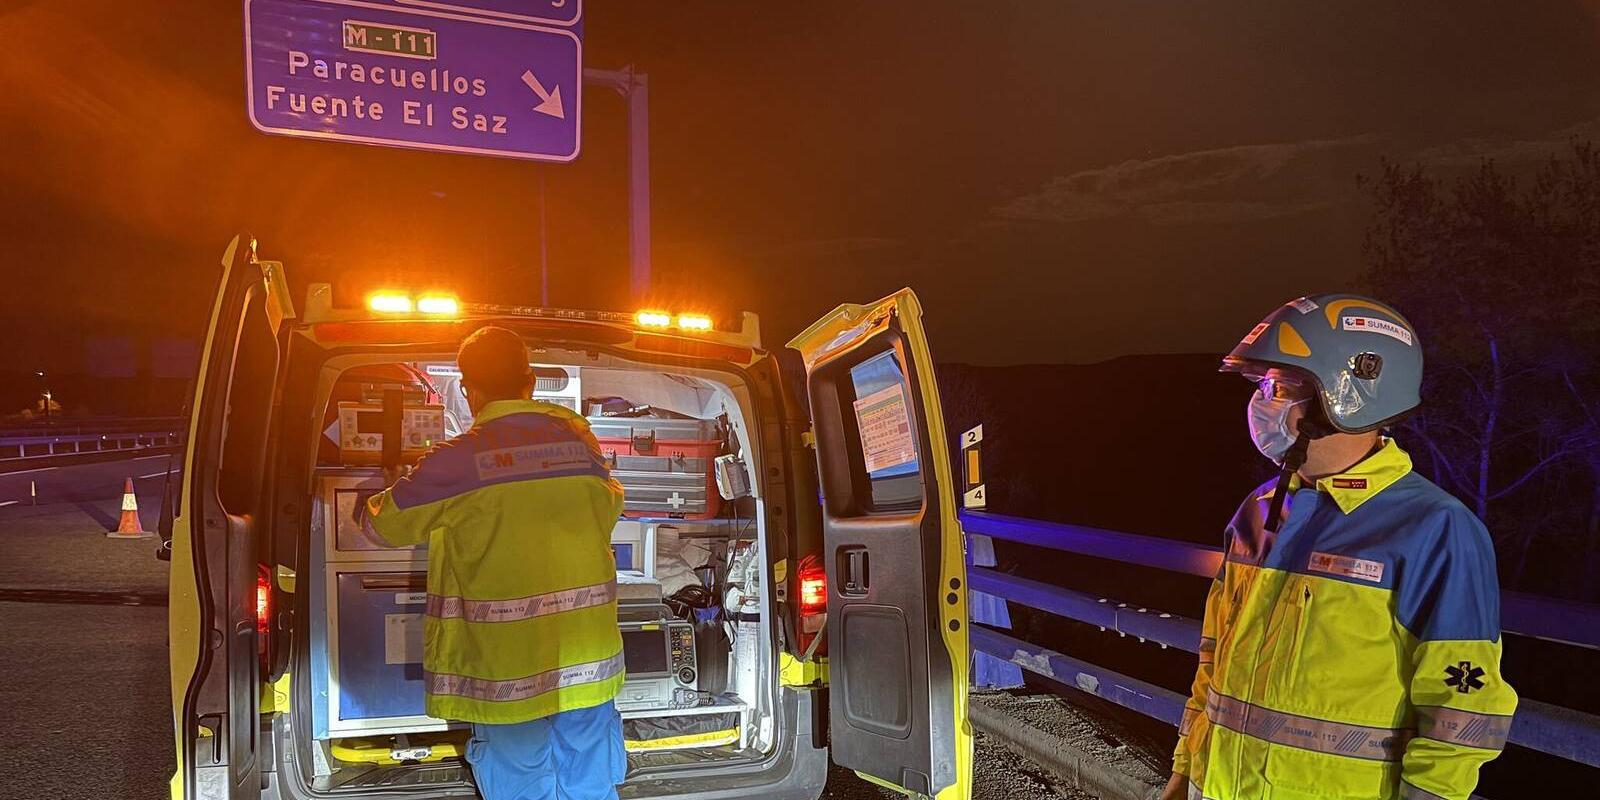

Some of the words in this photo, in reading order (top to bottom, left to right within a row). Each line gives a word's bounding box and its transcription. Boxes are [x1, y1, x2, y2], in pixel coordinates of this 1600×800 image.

[288, 51, 487, 97] Paracuellos
[266, 85, 384, 121] Fuente
[403, 100, 433, 126] El
[451, 106, 507, 134] Saz
[1367, 320, 1400, 334] SUMMA
[967, 431, 977, 442] 2
[515, 445, 565, 461] SUMMA
[974, 489, 983, 500] 4
[1365, 563, 1379, 573] 112
[562, 671, 583, 680] SUMMA
[1441, 720, 1458, 731] 112
[1284, 726, 1318, 739] SUMMA
[1322, 732, 1338, 743] 112
